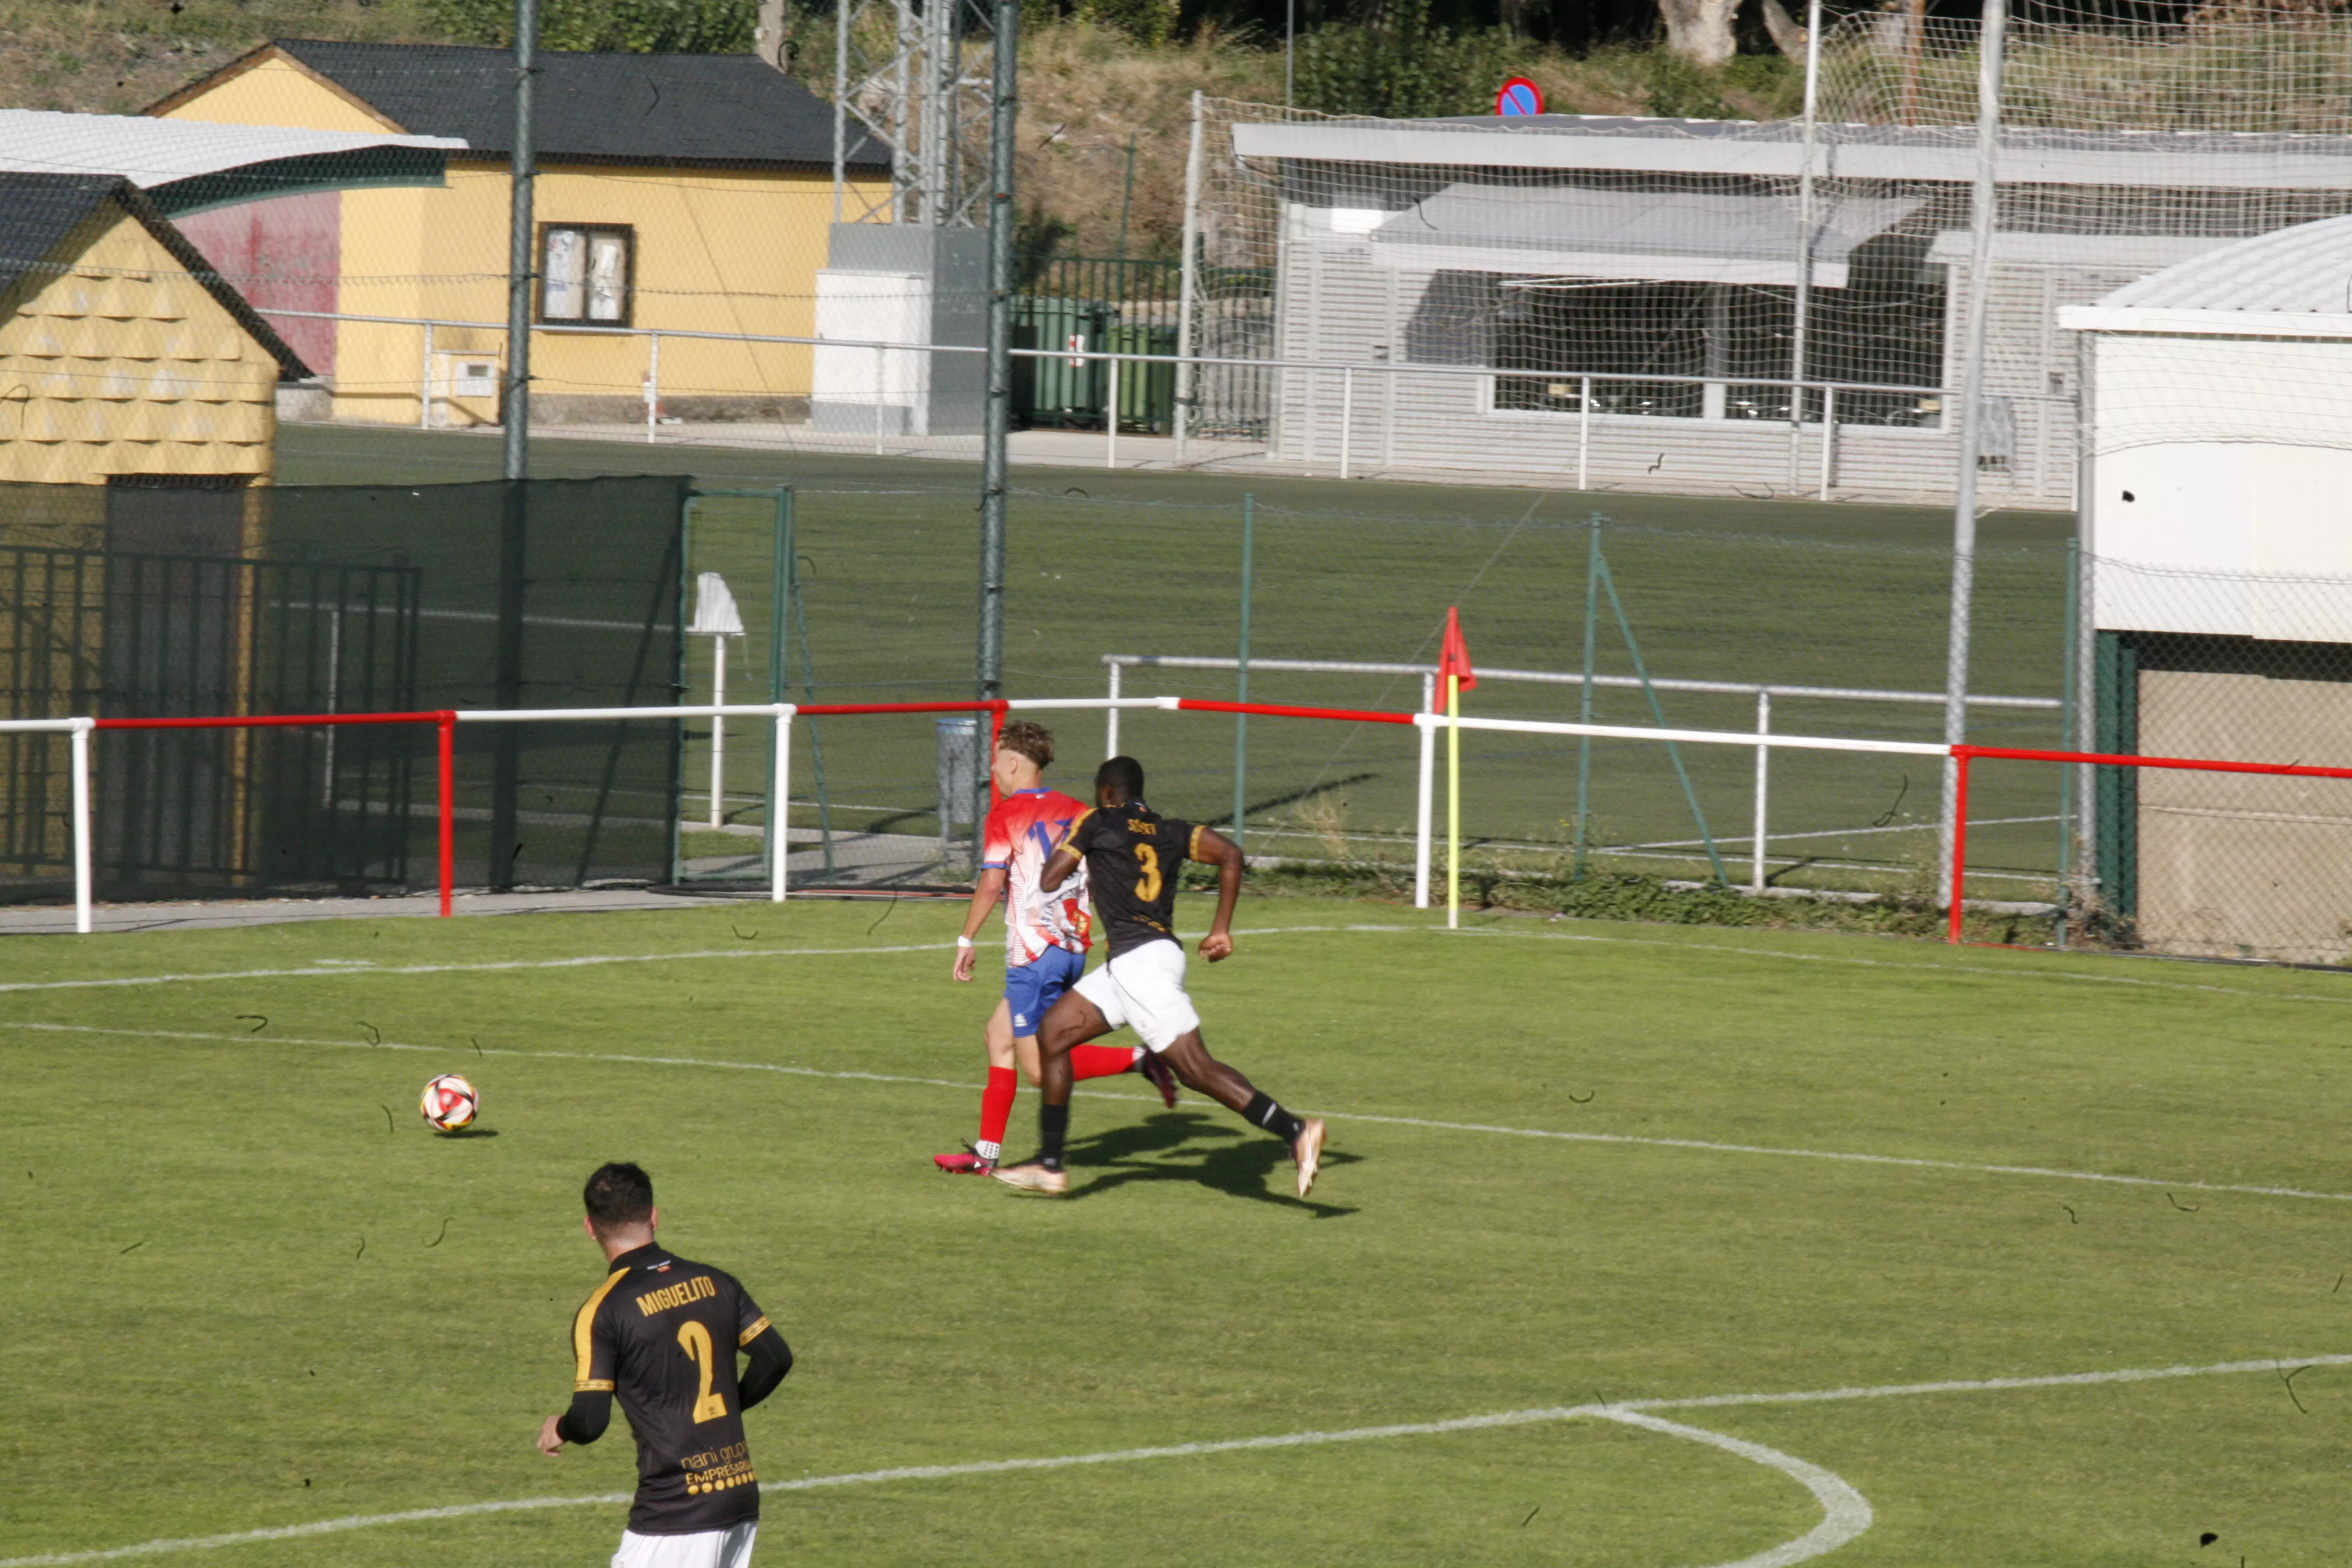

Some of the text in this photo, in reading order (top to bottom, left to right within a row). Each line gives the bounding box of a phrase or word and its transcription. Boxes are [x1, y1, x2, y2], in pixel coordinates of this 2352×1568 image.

[1135, 843, 1163, 902] 3
[636, 1276, 716, 1317] MIGUELITO
[677, 1320, 727, 1424] 2
